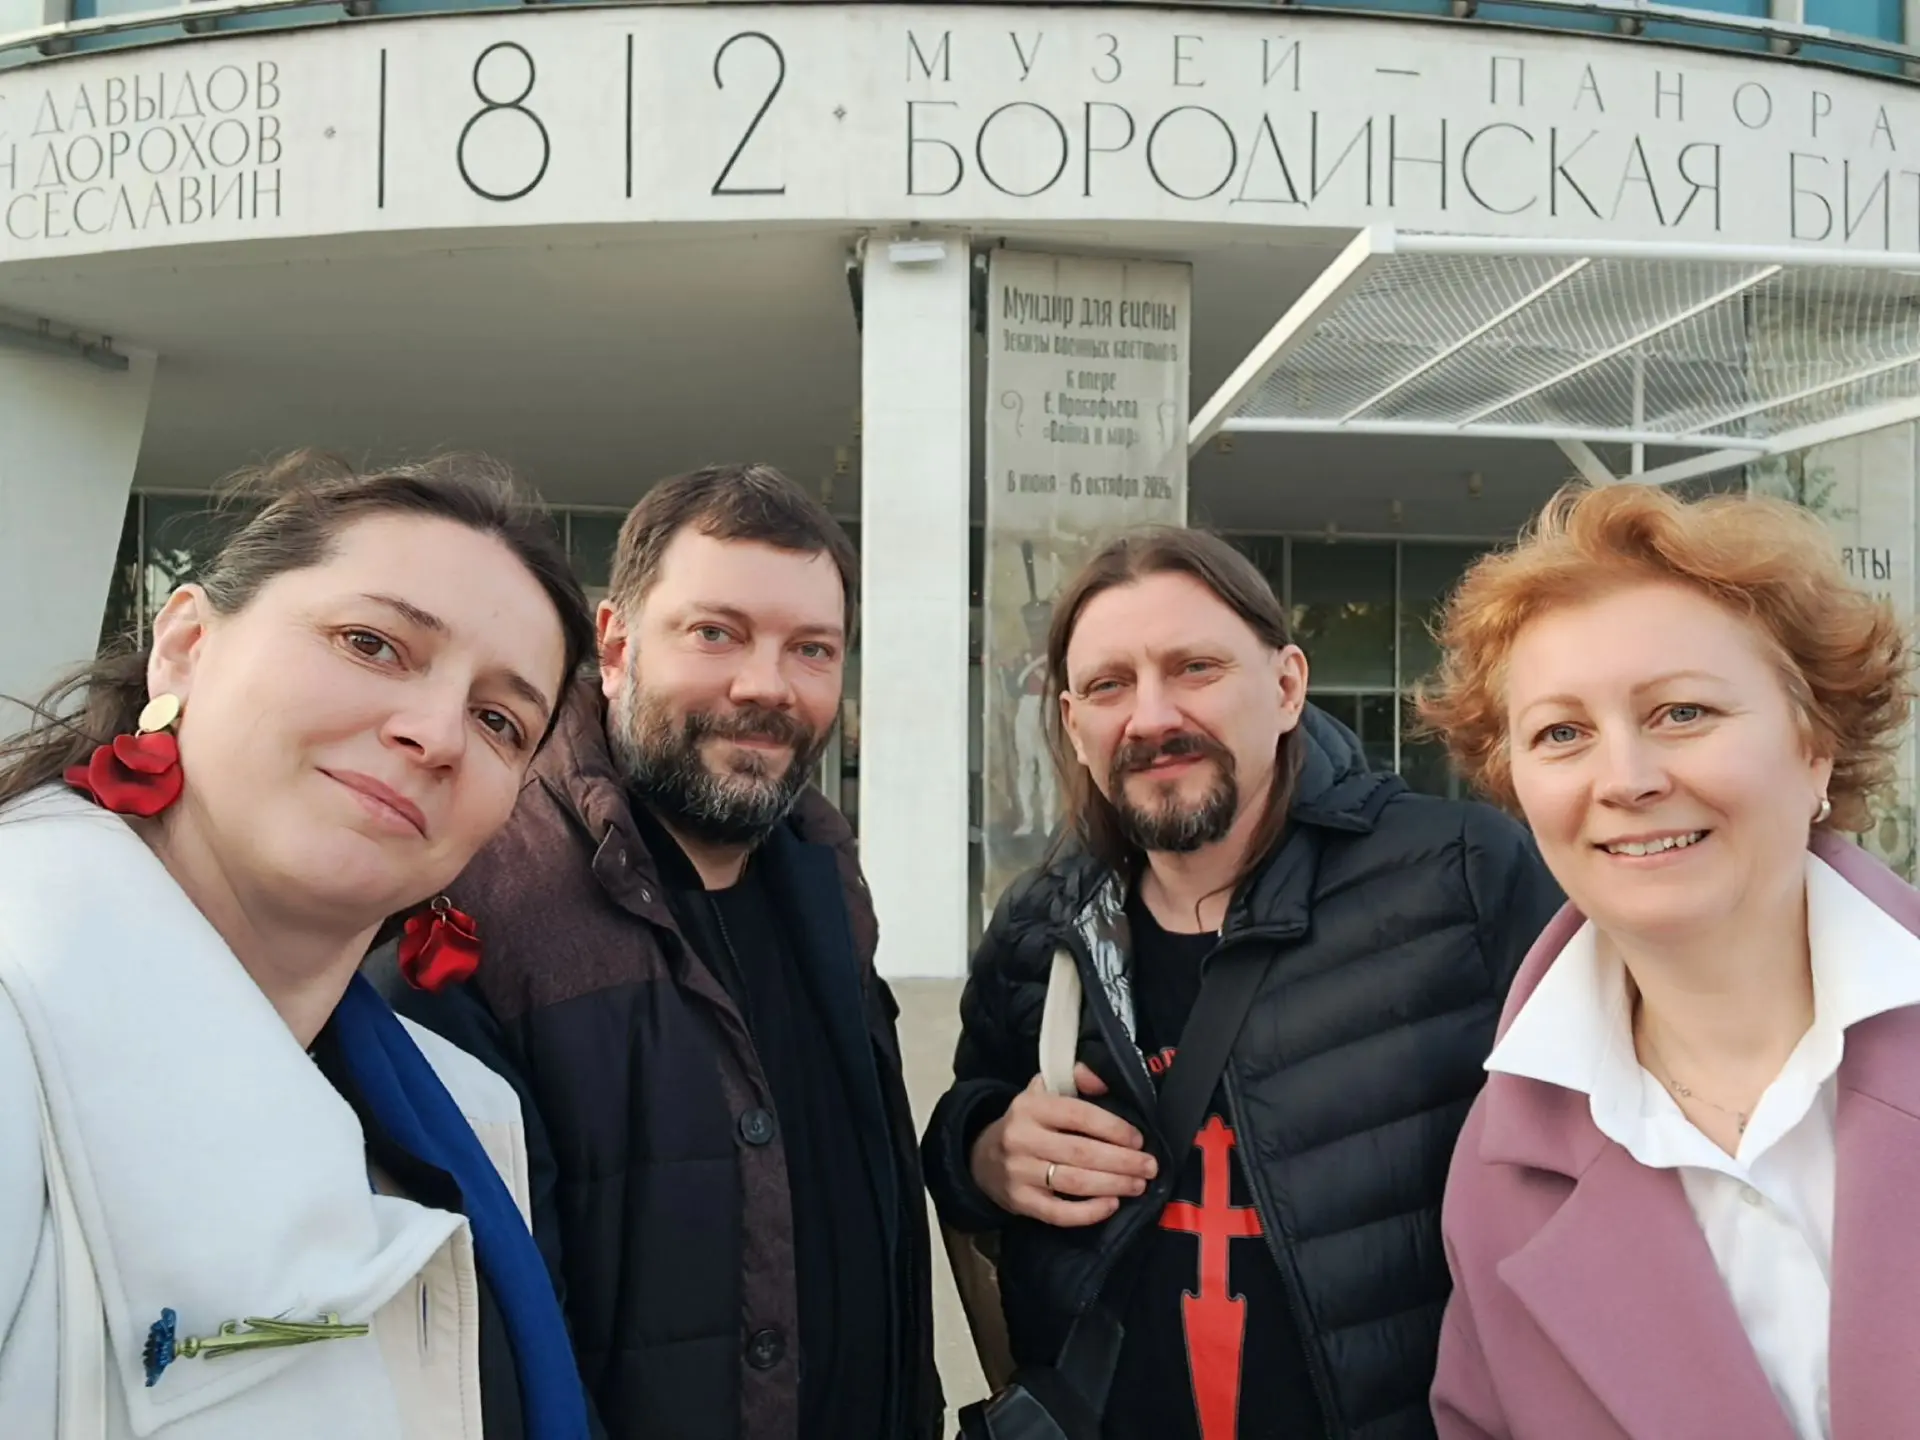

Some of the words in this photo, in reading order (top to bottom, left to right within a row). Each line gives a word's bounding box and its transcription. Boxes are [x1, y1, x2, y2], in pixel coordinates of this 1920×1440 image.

[31, 61, 281, 138] ДАВЫДОВ
[378, 31, 786, 209] 1812
[906, 30, 1301, 92] МУЗЕЙ
[1490, 56, 1896, 152] ПАНОРА
[33, 116, 282, 190] ДОРОХОВ
[906, 100, 1723, 232] БОРОДИНСКАЯ
[6, 169, 282, 240] СЕСЛАВИН
[1003, 285, 1074, 329] Мундир
